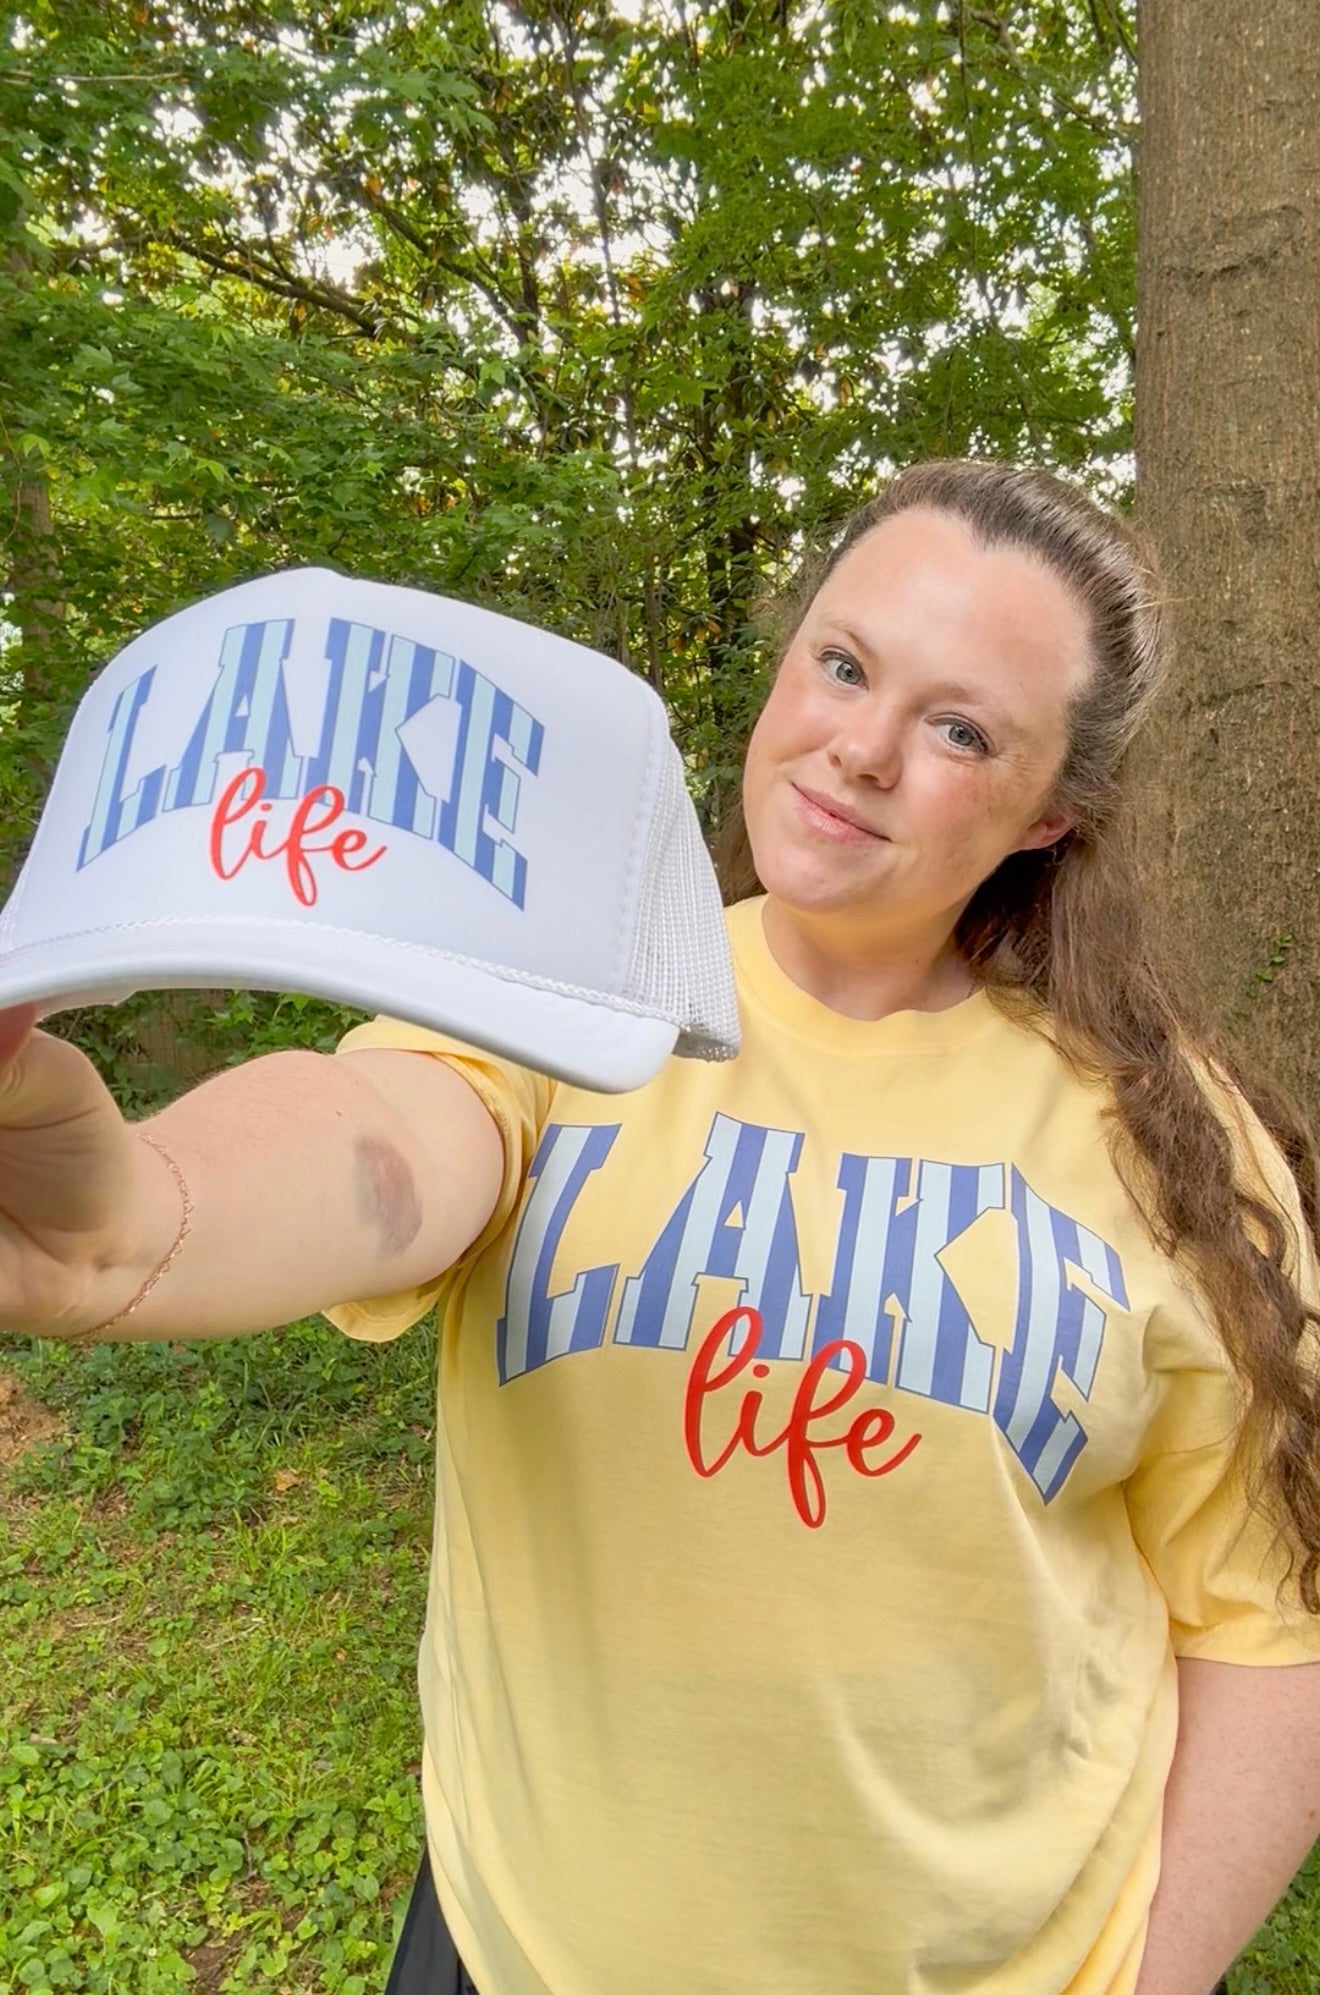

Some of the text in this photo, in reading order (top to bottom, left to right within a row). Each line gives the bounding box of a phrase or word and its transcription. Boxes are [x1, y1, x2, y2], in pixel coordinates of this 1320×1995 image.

[76, 617, 545, 911] LAKE
[210, 767, 388, 906] life
[496, 1111, 1130, 1506] LAKE
[684, 1306, 922, 1529] life
